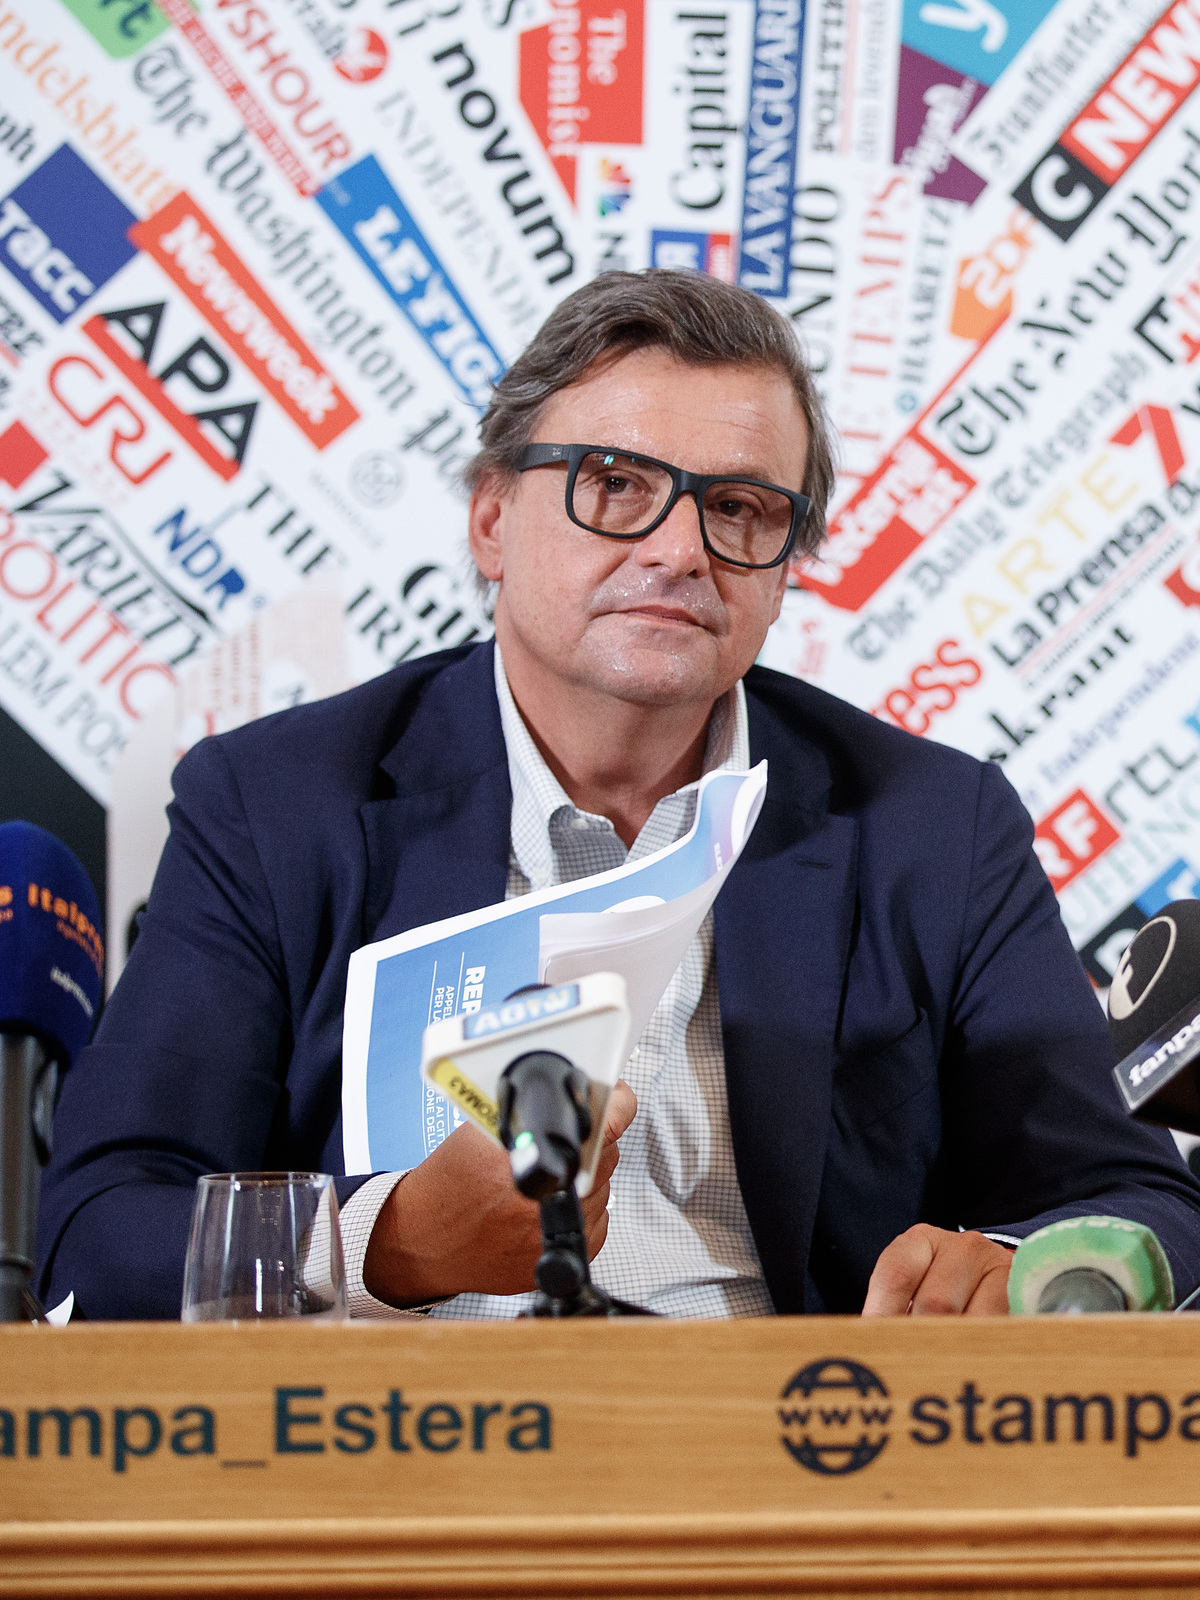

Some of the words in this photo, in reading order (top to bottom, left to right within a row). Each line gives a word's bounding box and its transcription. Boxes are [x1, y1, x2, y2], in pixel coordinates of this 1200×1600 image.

[215, 0, 352, 170] SHOUR
[586, 10, 628, 86] The
[672, 10, 740, 212] Capital
[430, 40, 578, 287] novum
[157, 212, 342, 427] Newsweek
[205, 125, 418, 412] Washington
[936, 346, 1037, 456] The
[1018, 242, 1137, 370] New
[48, 355, 174, 486] CRI
[103, 302, 259, 467] APA
[12, 470, 212, 668] VARIETY
[151, 508, 247, 612] NDR
[990, 620, 1043, 667] La
[1034, 503, 1170, 626] Prensa
[433, 986, 446, 1010] PER
[461, 965, 487, 1016] REP
[777, 1404, 893, 1428] www
